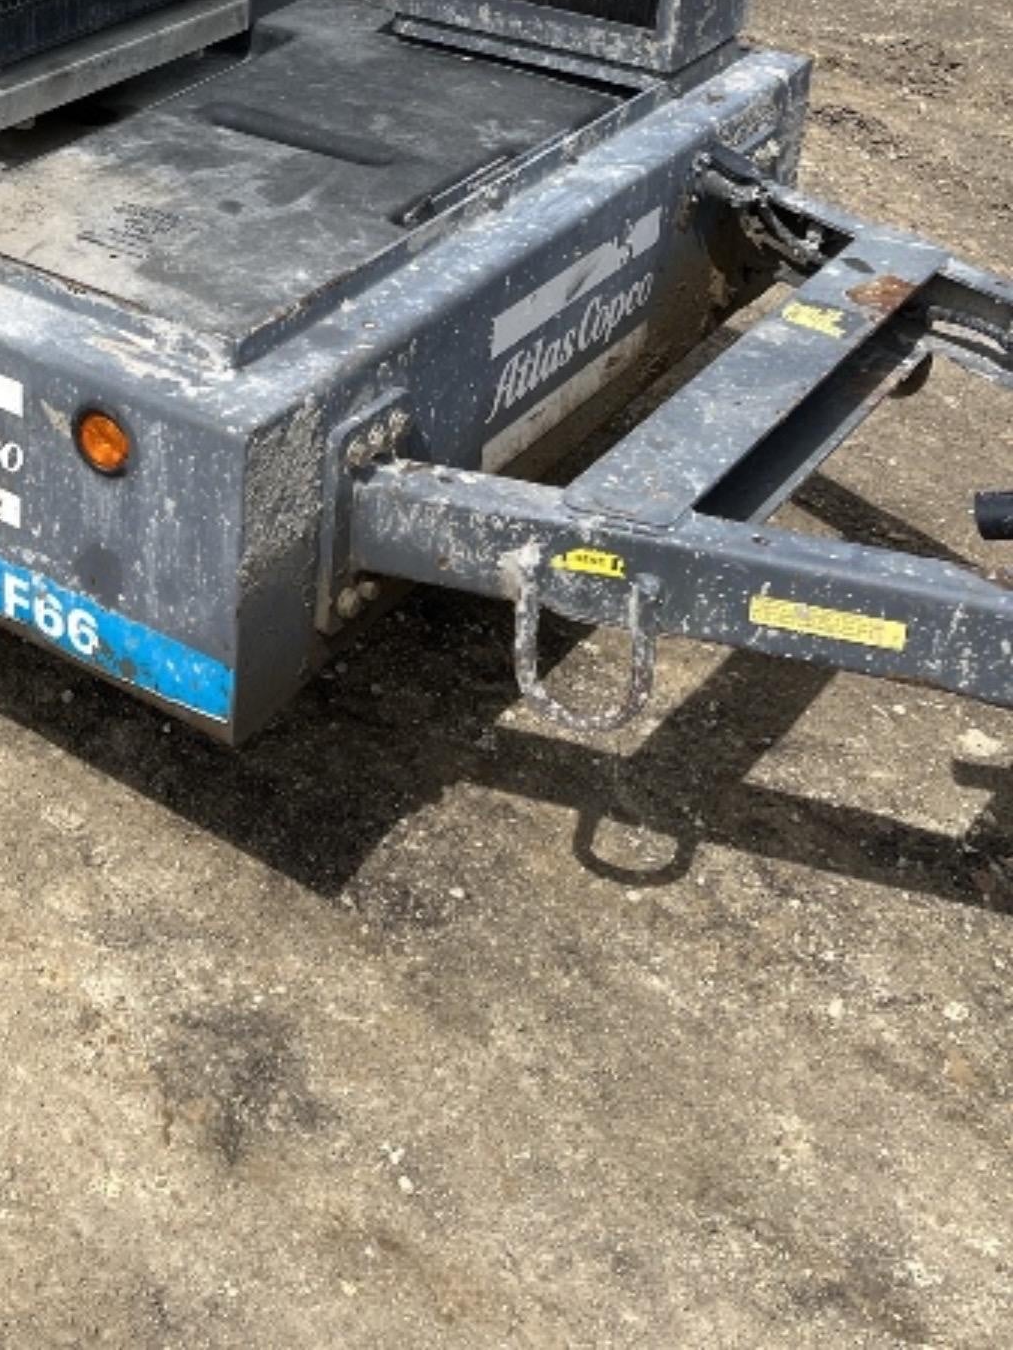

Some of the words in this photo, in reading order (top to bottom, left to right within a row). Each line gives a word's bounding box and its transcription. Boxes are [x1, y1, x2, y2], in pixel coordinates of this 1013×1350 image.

[484, 327, 576, 425] Atlas
[577, 272, 654, 352] Copco
[3, 571, 100, 656] F66
